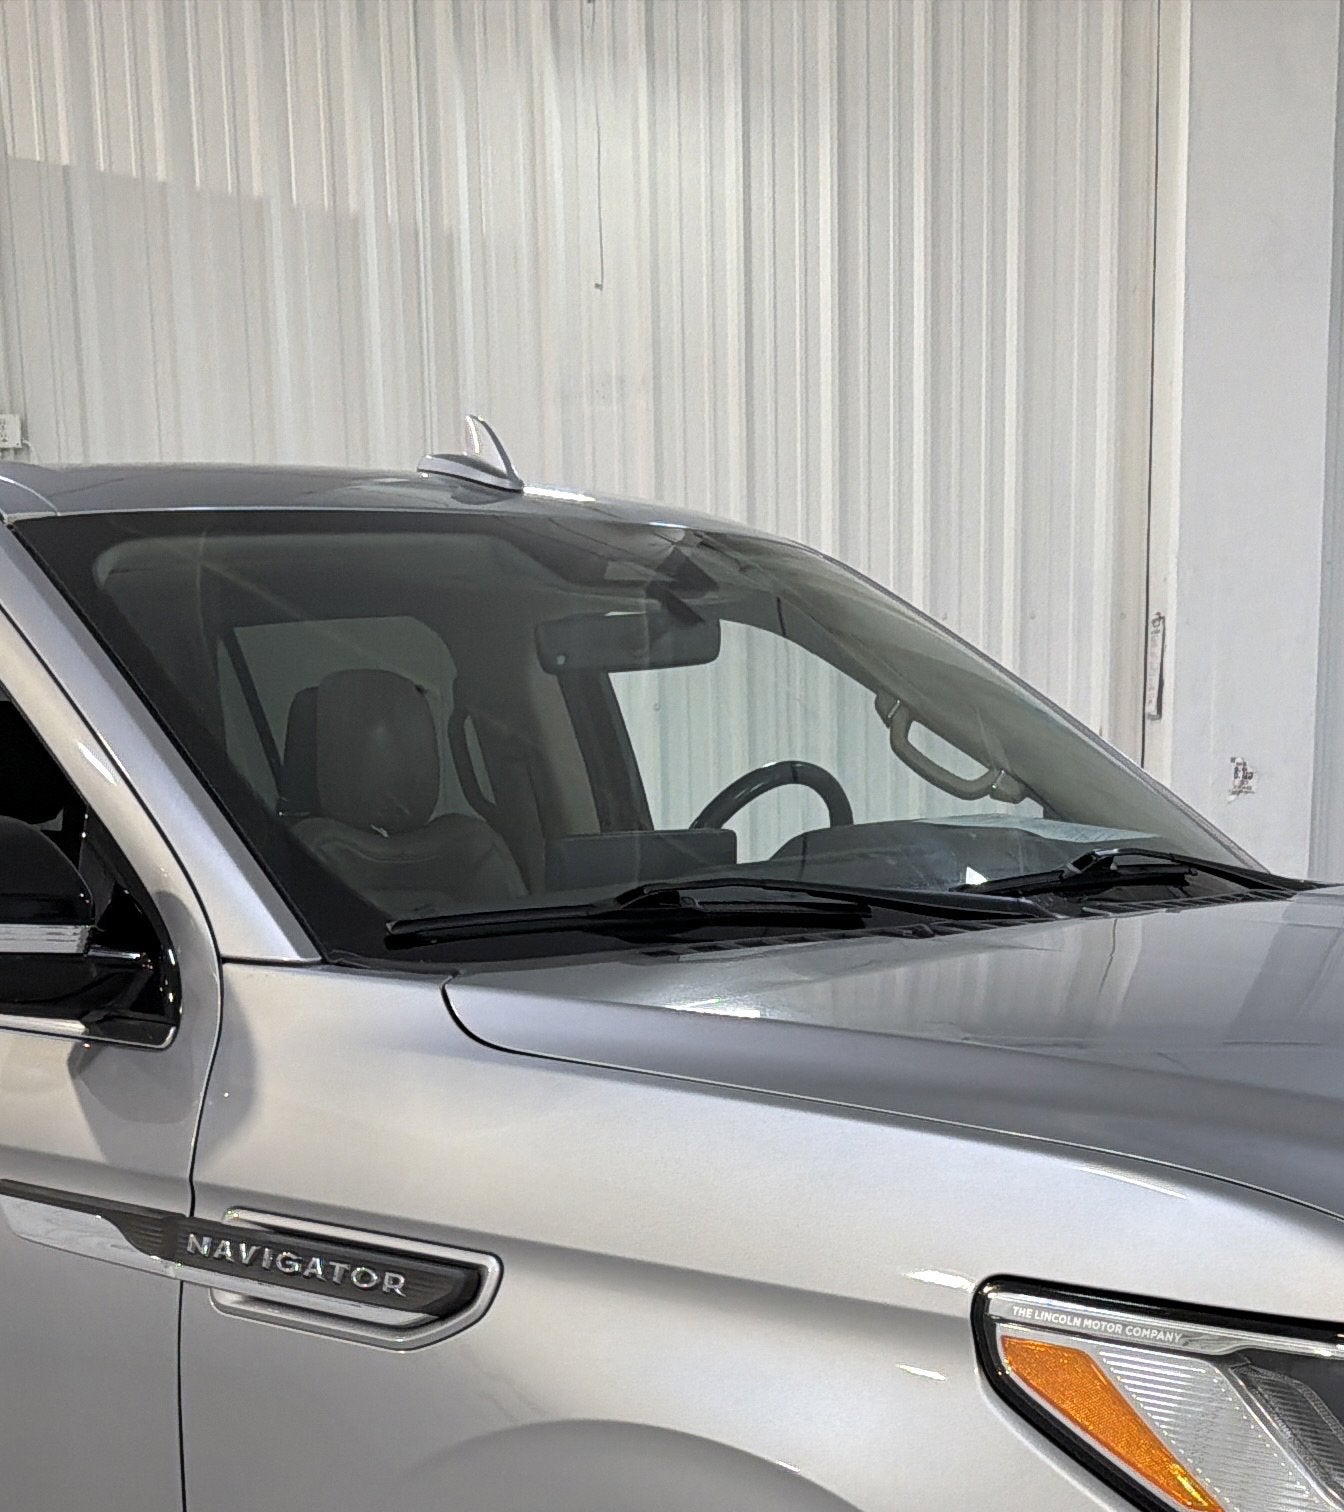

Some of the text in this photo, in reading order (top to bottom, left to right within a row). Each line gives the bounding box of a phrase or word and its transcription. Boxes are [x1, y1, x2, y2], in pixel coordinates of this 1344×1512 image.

[186, 1232, 407, 1298] NAVIGATOR
[1012, 1306, 1183, 1343] THE LINCOLN MOTOR COMPANY
